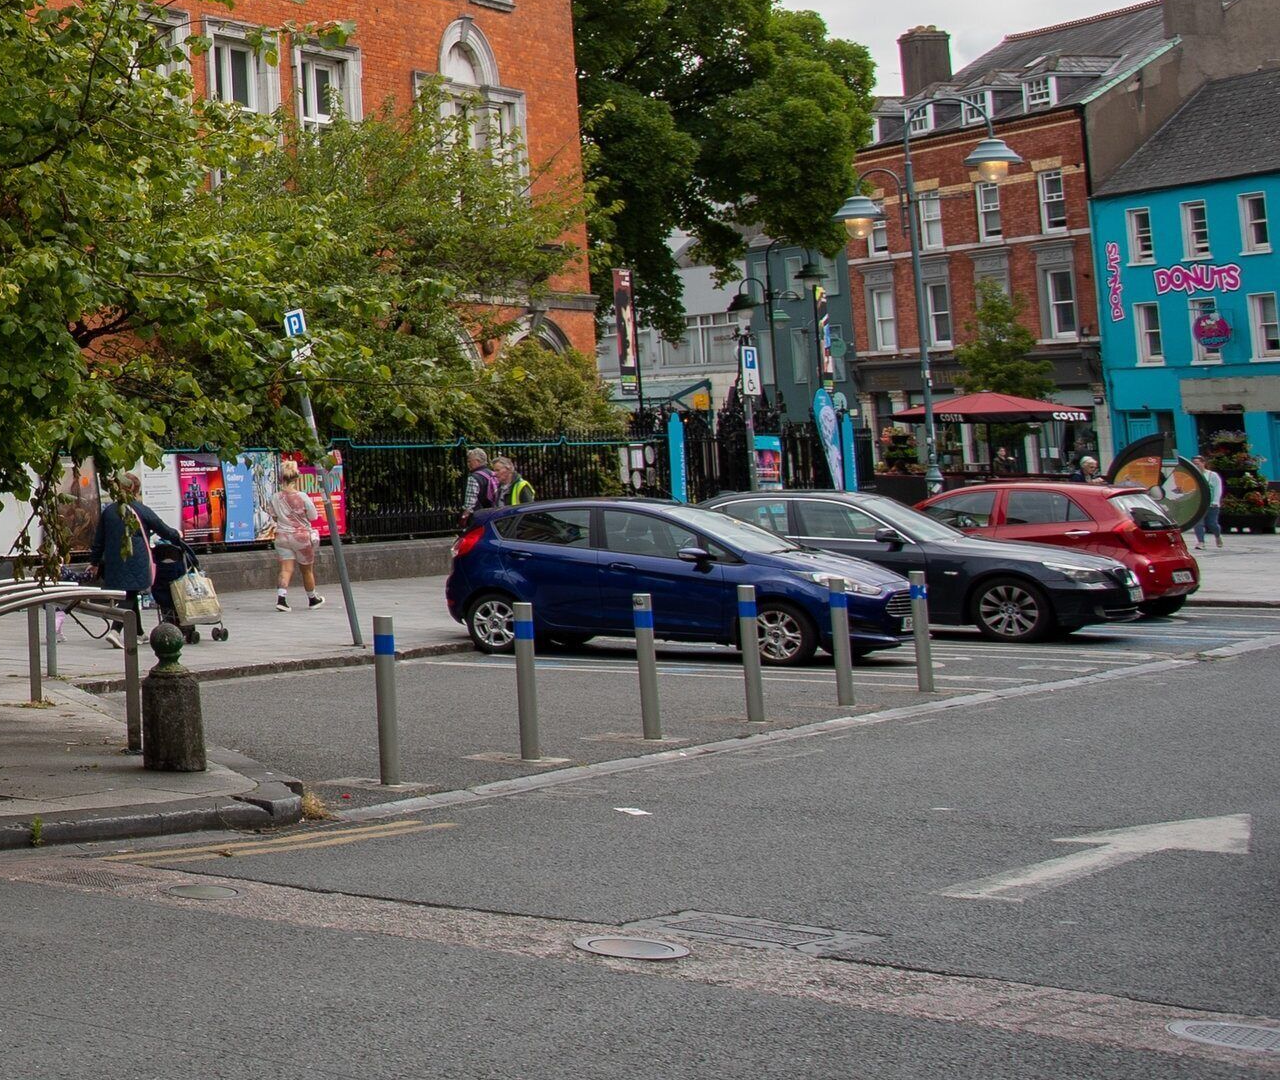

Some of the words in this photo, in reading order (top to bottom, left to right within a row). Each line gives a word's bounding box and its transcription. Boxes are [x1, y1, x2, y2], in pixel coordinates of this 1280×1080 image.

[1106, 242, 1125, 321] DONUTS
[1153, 263, 1241, 295] DONUTS
[940, 413, 964, 423] COSTA
[1052, 411, 1087, 422] COSTA
[226, 474, 244, 482] Gallery
